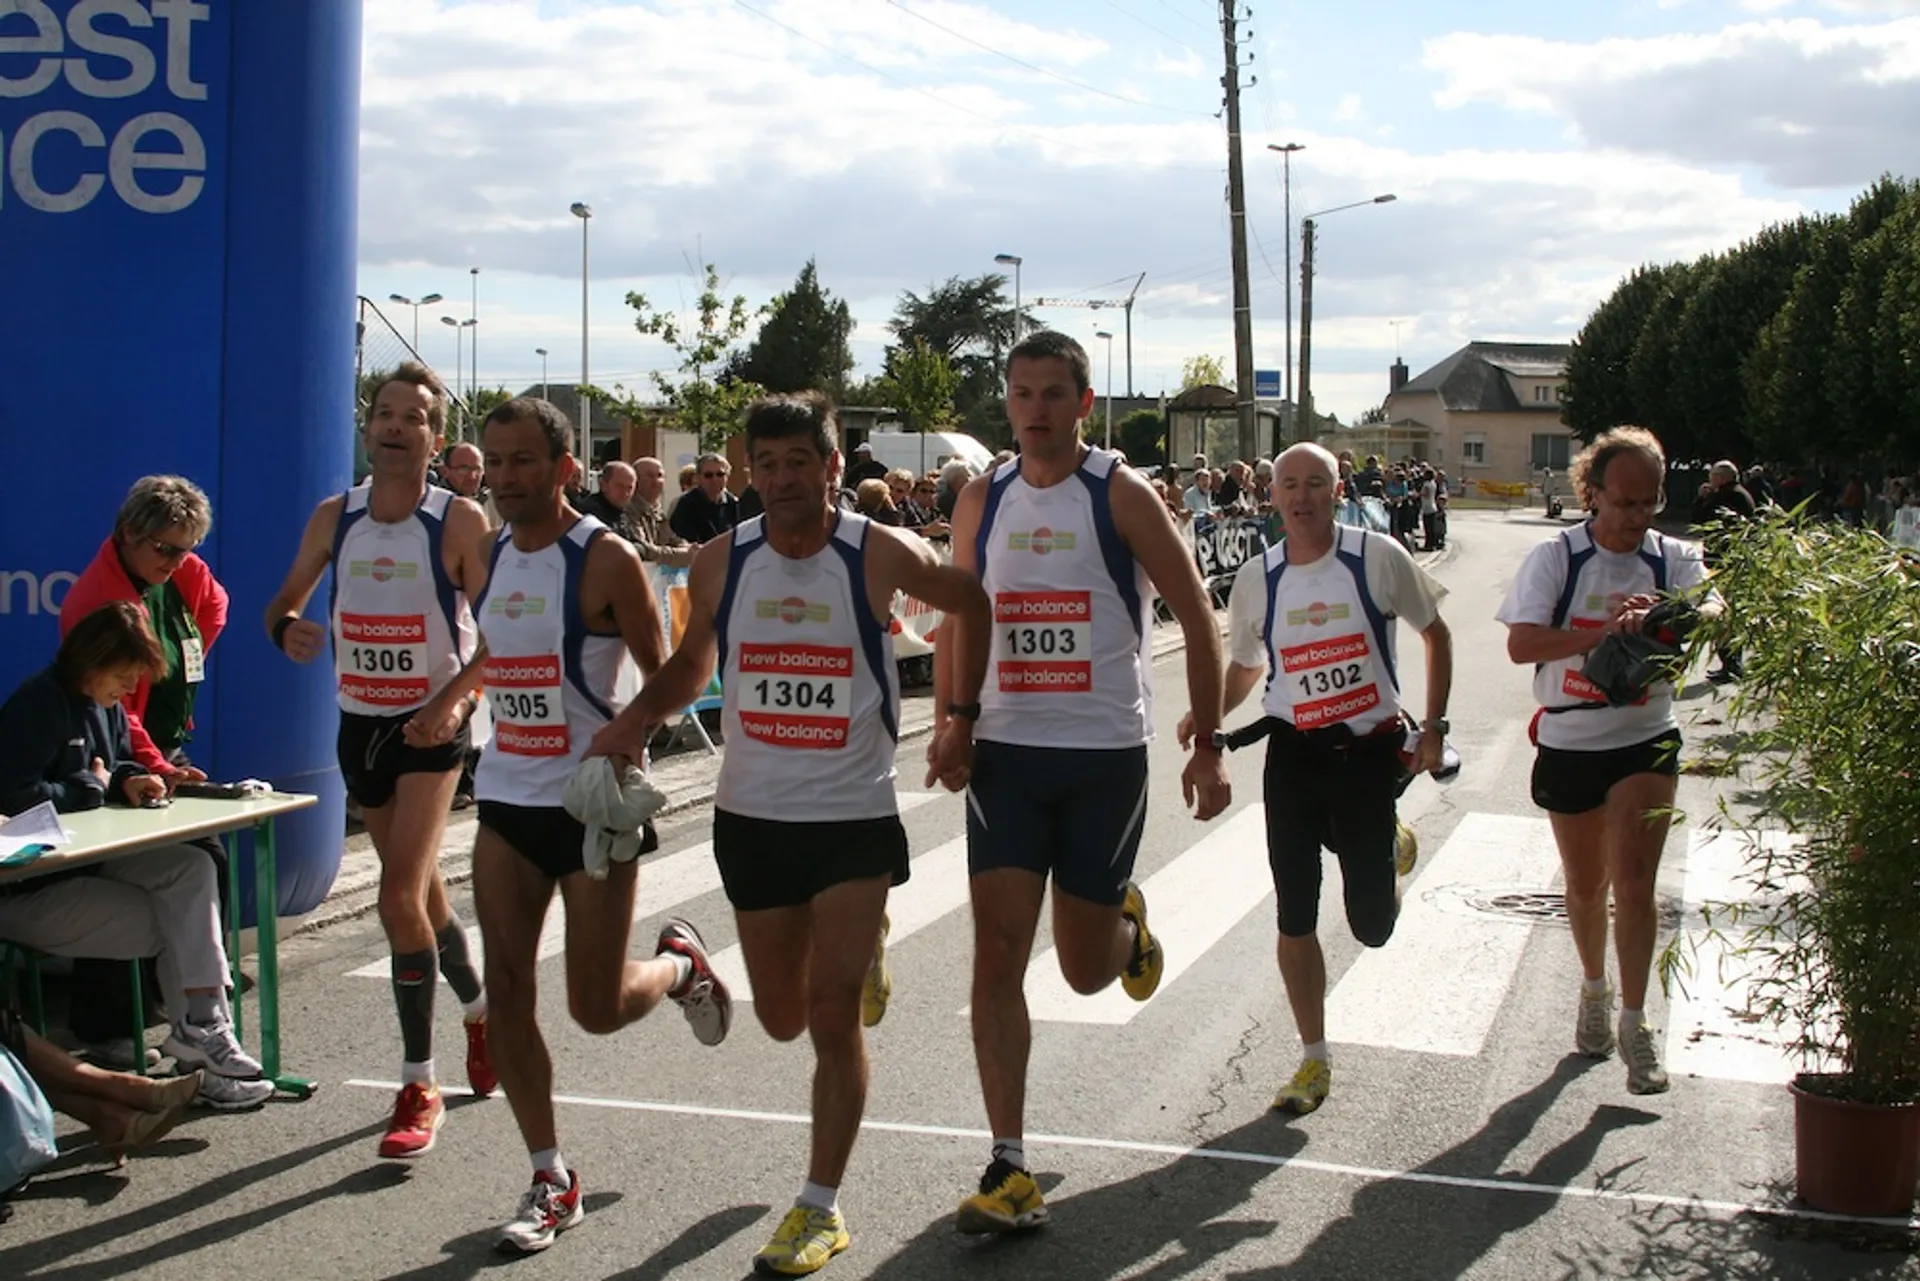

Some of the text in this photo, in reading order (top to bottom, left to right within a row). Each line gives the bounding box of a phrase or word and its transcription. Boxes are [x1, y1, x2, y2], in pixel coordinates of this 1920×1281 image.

[0, 0, 210, 100] est
[0, 110, 206, 214] ce
[1023, 599, 1087, 615] balance
[363, 622, 422, 637] balance
[1007, 628, 1076, 654] 1303
[352, 646, 414, 672] 1306
[743, 651, 848, 669] new balance
[1284, 641, 1365, 667] new balance
[500, 665, 556, 680] balance
[1023, 668, 1087, 685] balance
[1299, 663, 1362, 697] 1302
[366, 685, 426, 699] balance
[754, 679, 835, 710] 1304
[1296, 691, 1377, 725] new balance
[743, 720, 844, 741] new balance
